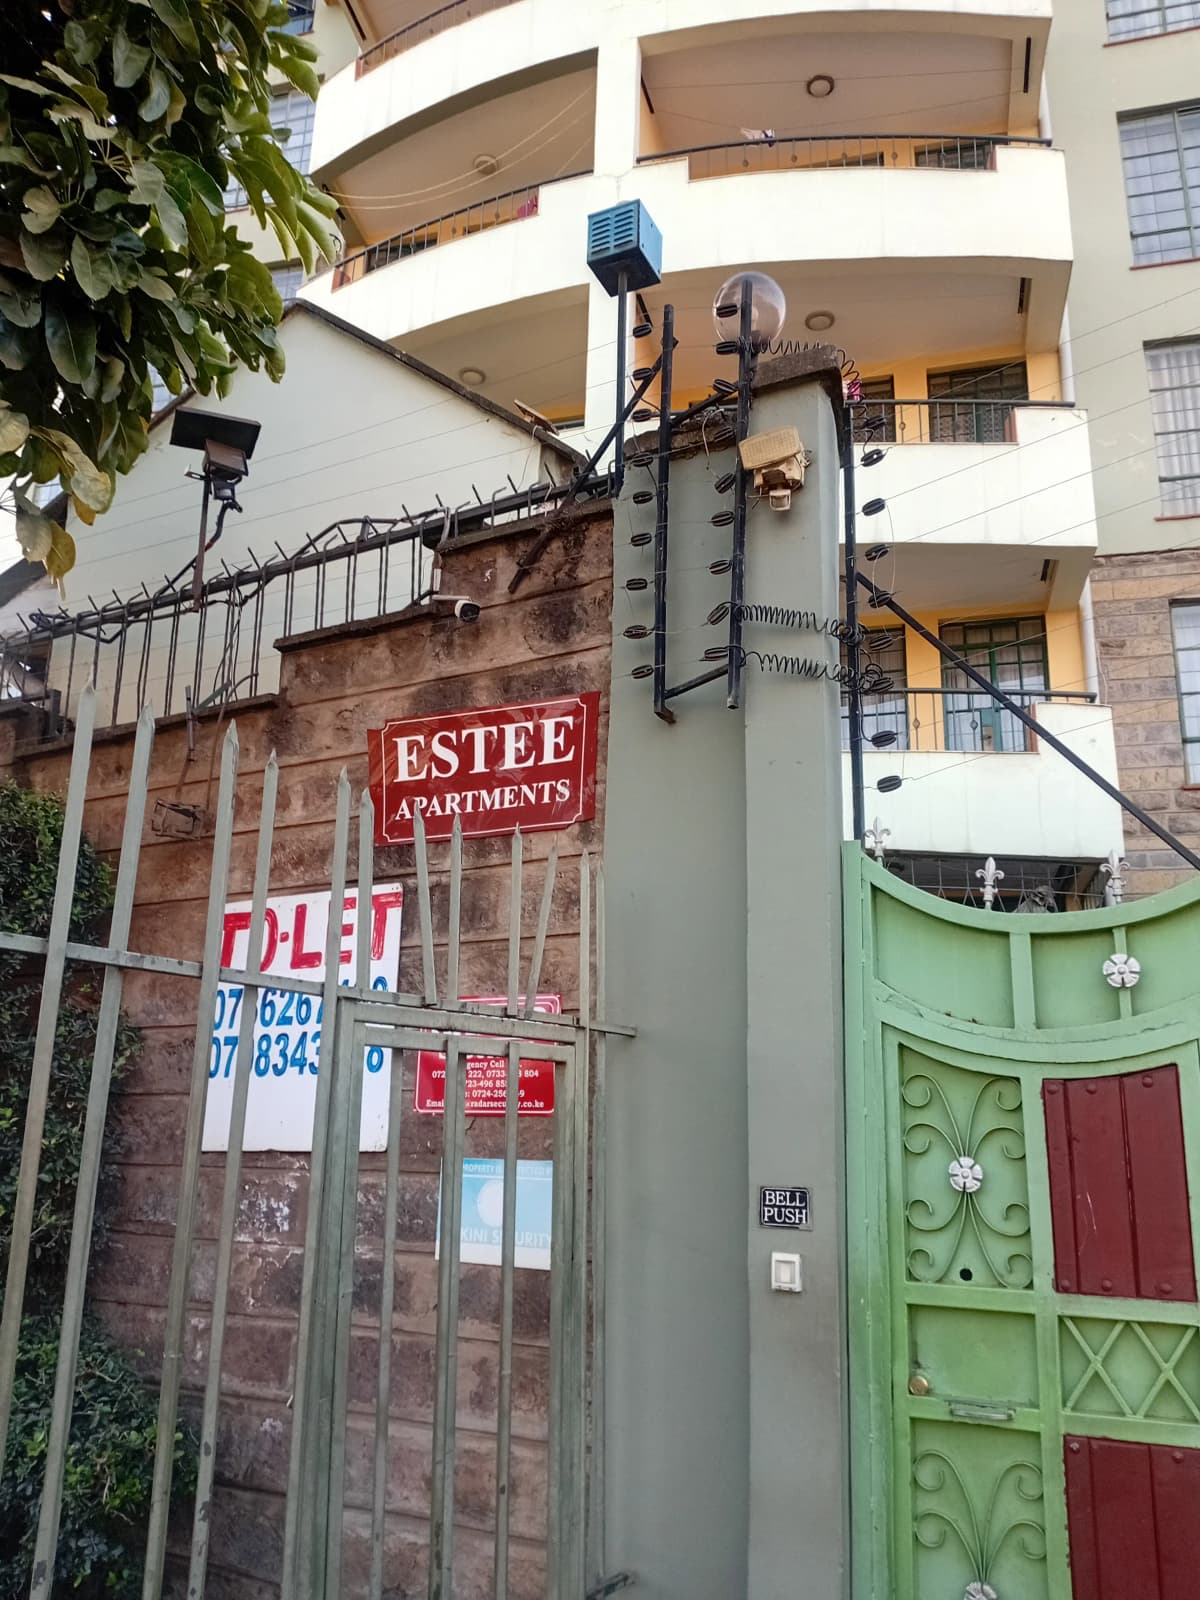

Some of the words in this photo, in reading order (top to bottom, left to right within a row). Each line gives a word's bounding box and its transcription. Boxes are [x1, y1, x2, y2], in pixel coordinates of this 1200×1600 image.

[392, 716, 575, 783] ESTEE
[395, 779, 570, 820] APARTMENTS
[765, 1191, 806, 1206] BELL
[764, 1207, 807, 1224] PUSH
